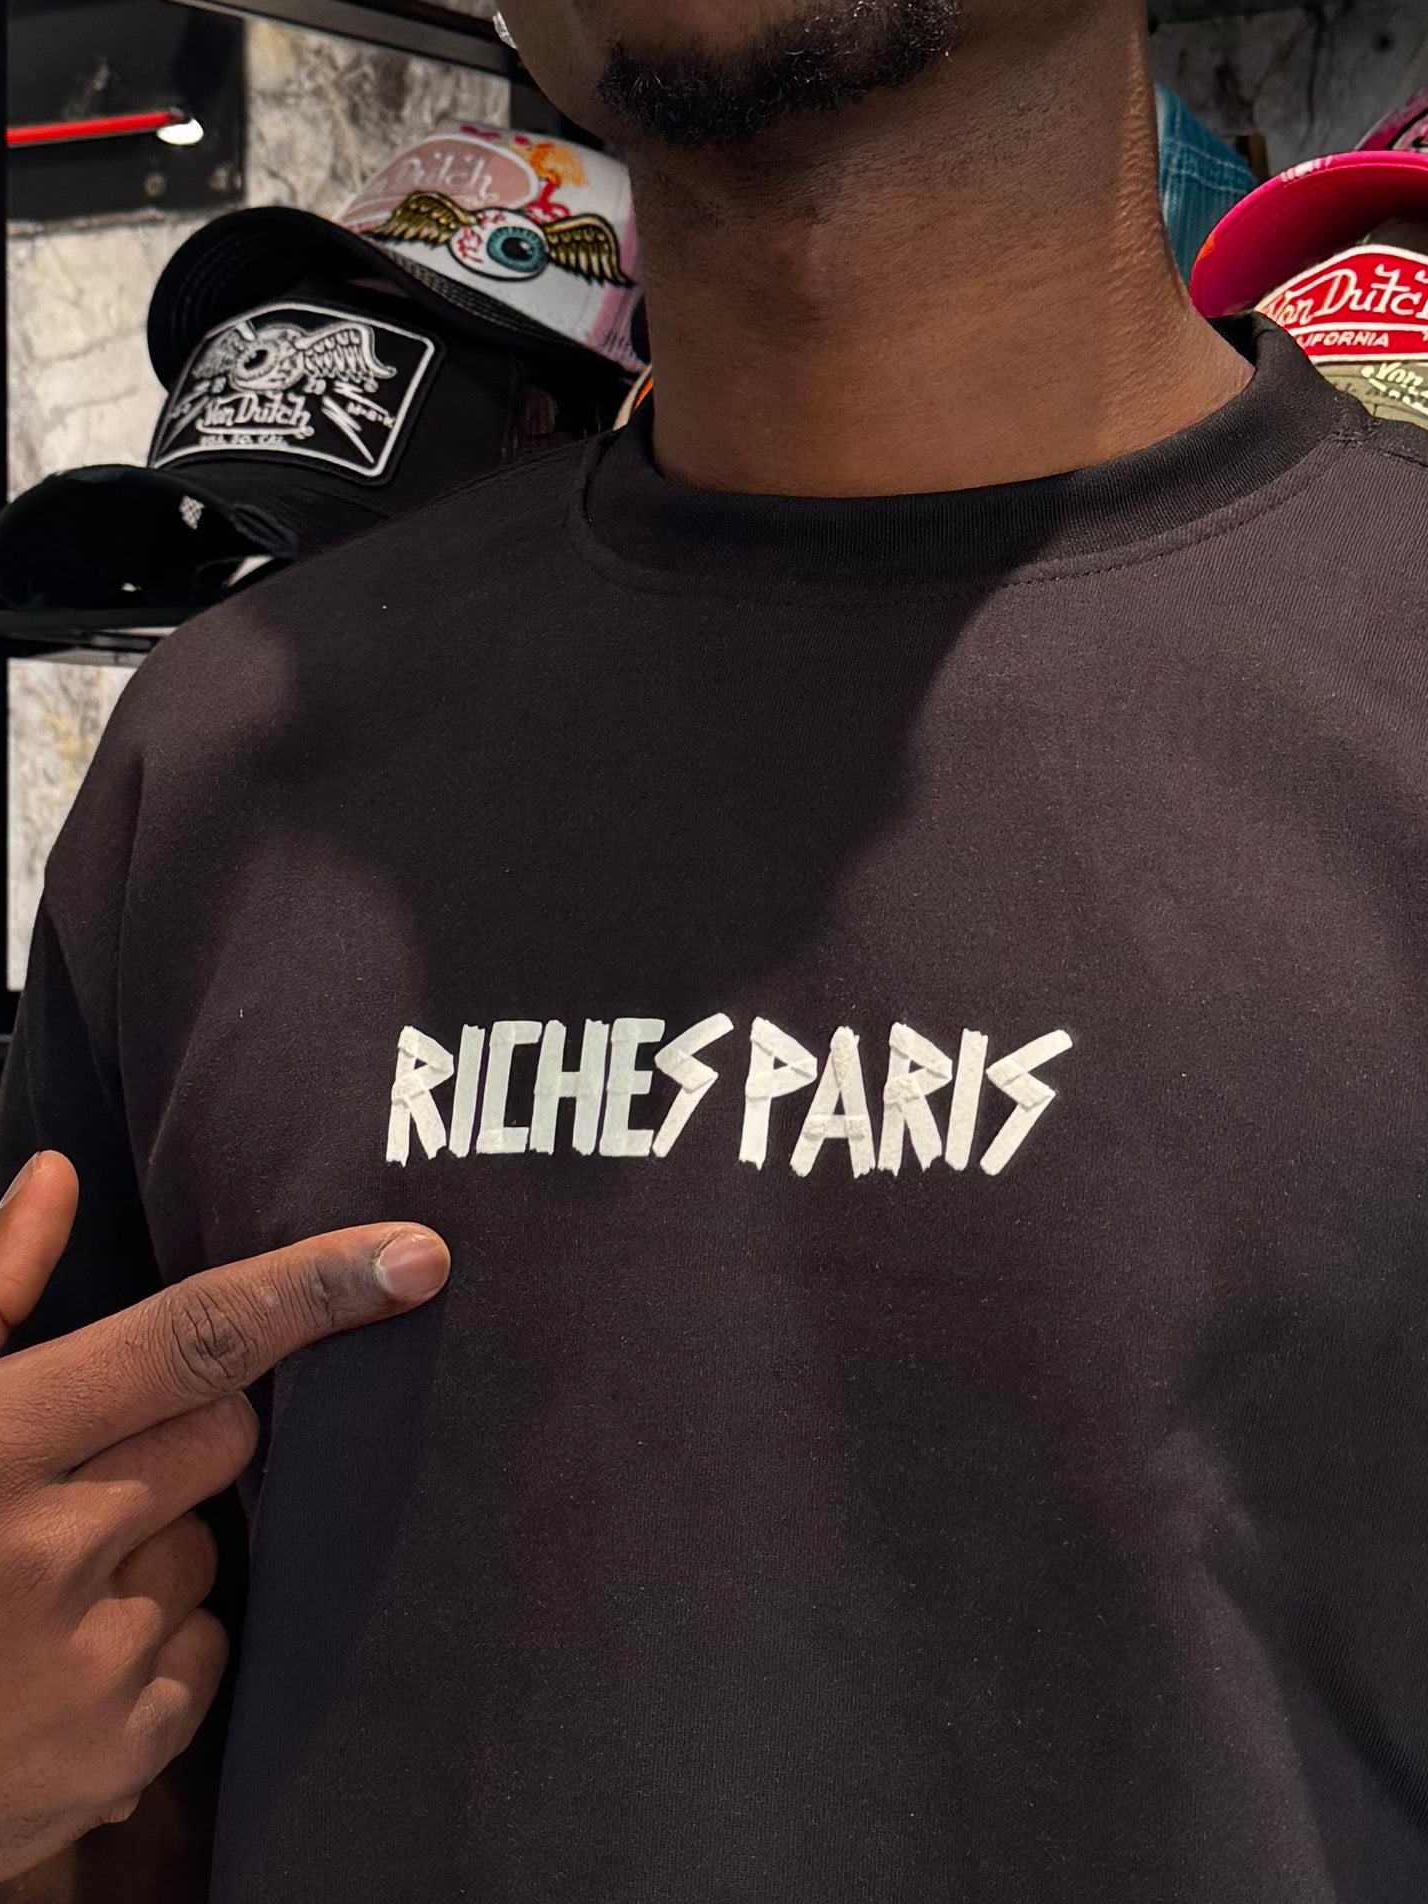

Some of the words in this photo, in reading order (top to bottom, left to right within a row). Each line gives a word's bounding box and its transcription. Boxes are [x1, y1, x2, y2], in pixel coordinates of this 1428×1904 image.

[197, 402, 235, 428] Von
[235, 391, 313, 429] Dutch
[386, 1011, 734, 1167] RICHES
[738, 1016, 1074, 1179] PARIS
